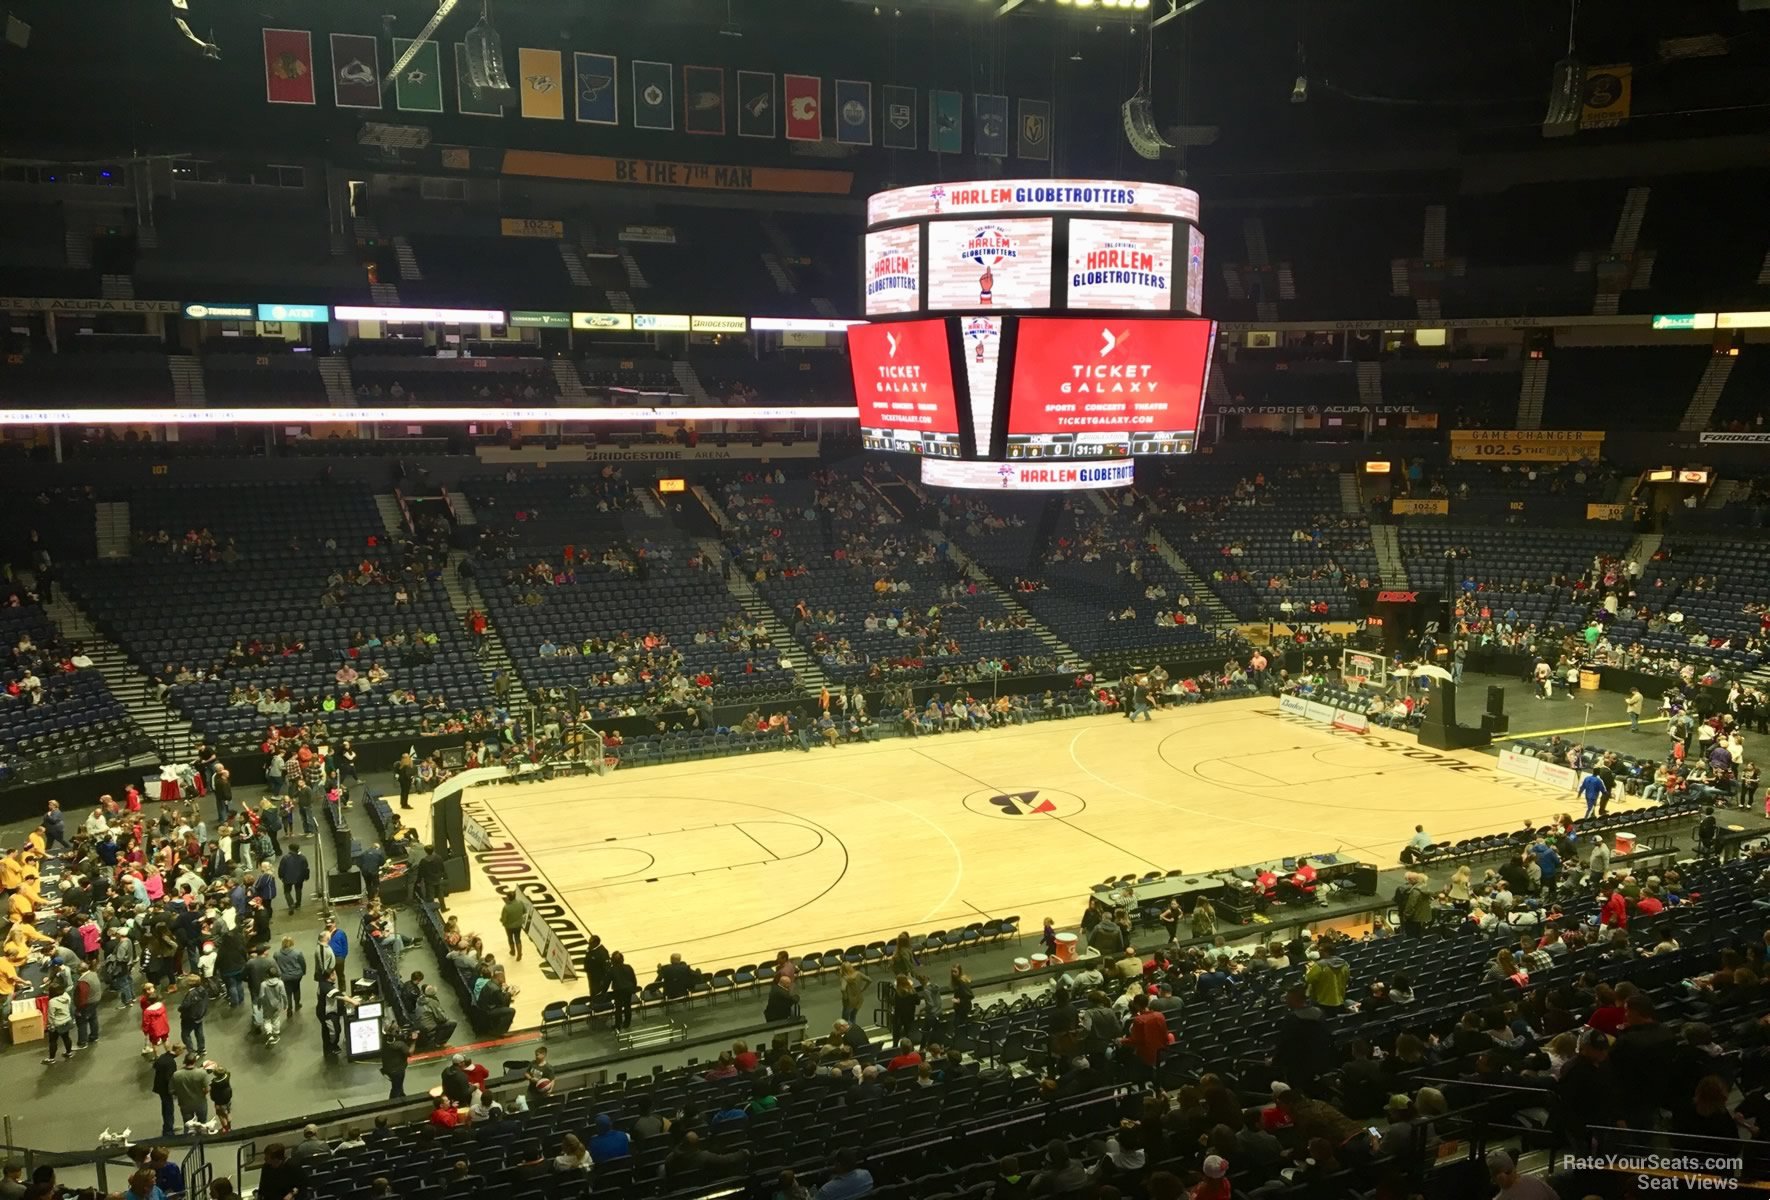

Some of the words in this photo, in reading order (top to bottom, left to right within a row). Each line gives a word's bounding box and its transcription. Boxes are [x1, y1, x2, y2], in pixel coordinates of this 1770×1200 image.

[615, 161, 638, 182] BE
[646, 163, 677, 184] THE
[683, 165, 709, 186] 7TH
[714, 168, 753, 188] MAN
[951, 188, 1012, 205] HARLEM
[1016, 187, 1135, 204] GLOBETROTTERS
[969, 237, 1010, 249] HARLEM
[962, 247, 1017, 259] GLOBETROTTERS
[874, 255, 909, 276] HARLEM
[1087, 250, 1153, 272] HARLEM
[51, 300, 113, 310] ACURA
[123, 301, 181, 311] LEVEL
[588, 316, 615, 327] Ford
[693, 319, 745, 329] BRIDGESTONE
[1493, 318, 1540, 327] LEVEL
[878, 365, 921, 379] TICKET
[1071, 364, 1153, 379] TICKET
[876, 382, 928, 393] GALAXY
[1060, 381, 1158, 394] GALAXY
[1044, 403, 1077, 412] SPORTS
[1084, 402, 1127, 411] CONCERTS
[1218, 406, 1253, 415] GARY
[1259, 406, 1304, 414] FORCE
[1376, 405, 1419, 413] LEVEL
[1058, 415, 1154, 425] TICKETGALAXY.COM
[1472, 431, 1508, 440] GAME
[1516, 431, 1583, 440] CHANGER
[1054, 444, 1062, 455] 0
[1077, 445, 1104, 455] 31:19
[1142, 442, 1149, 452] 0
[1474, 444, 1522, 456] 102.5
[1525, 446, 1545, 454] THE
[1546, 445, 1597, 457] GAME
[586, 451, 682, 461] BRIDGESTONE
[694, 450, 730, 459] ARENA
[1020, 470, 1077, 483] HARLEM
[1510, 501, 1525, 511] 102
